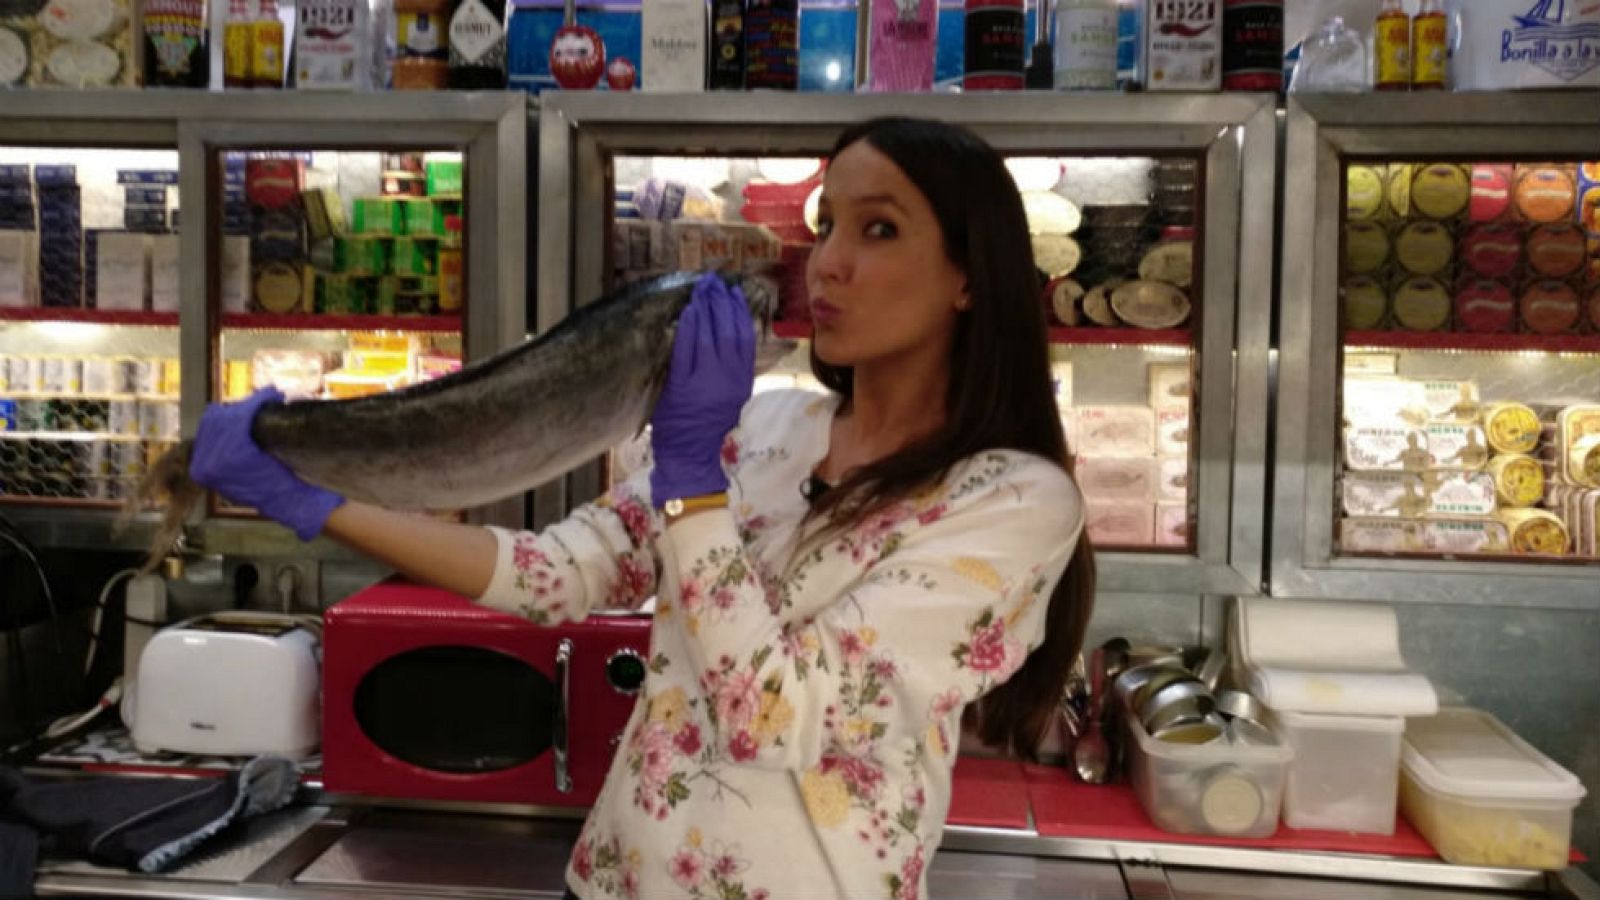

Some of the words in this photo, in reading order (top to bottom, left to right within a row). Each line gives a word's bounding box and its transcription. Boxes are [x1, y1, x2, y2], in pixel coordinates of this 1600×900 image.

[1155, 1, 1215, 20] 1921
[1501, 29, 1557, 64] Bonilla
[1577, 37, 1591, 60] la
